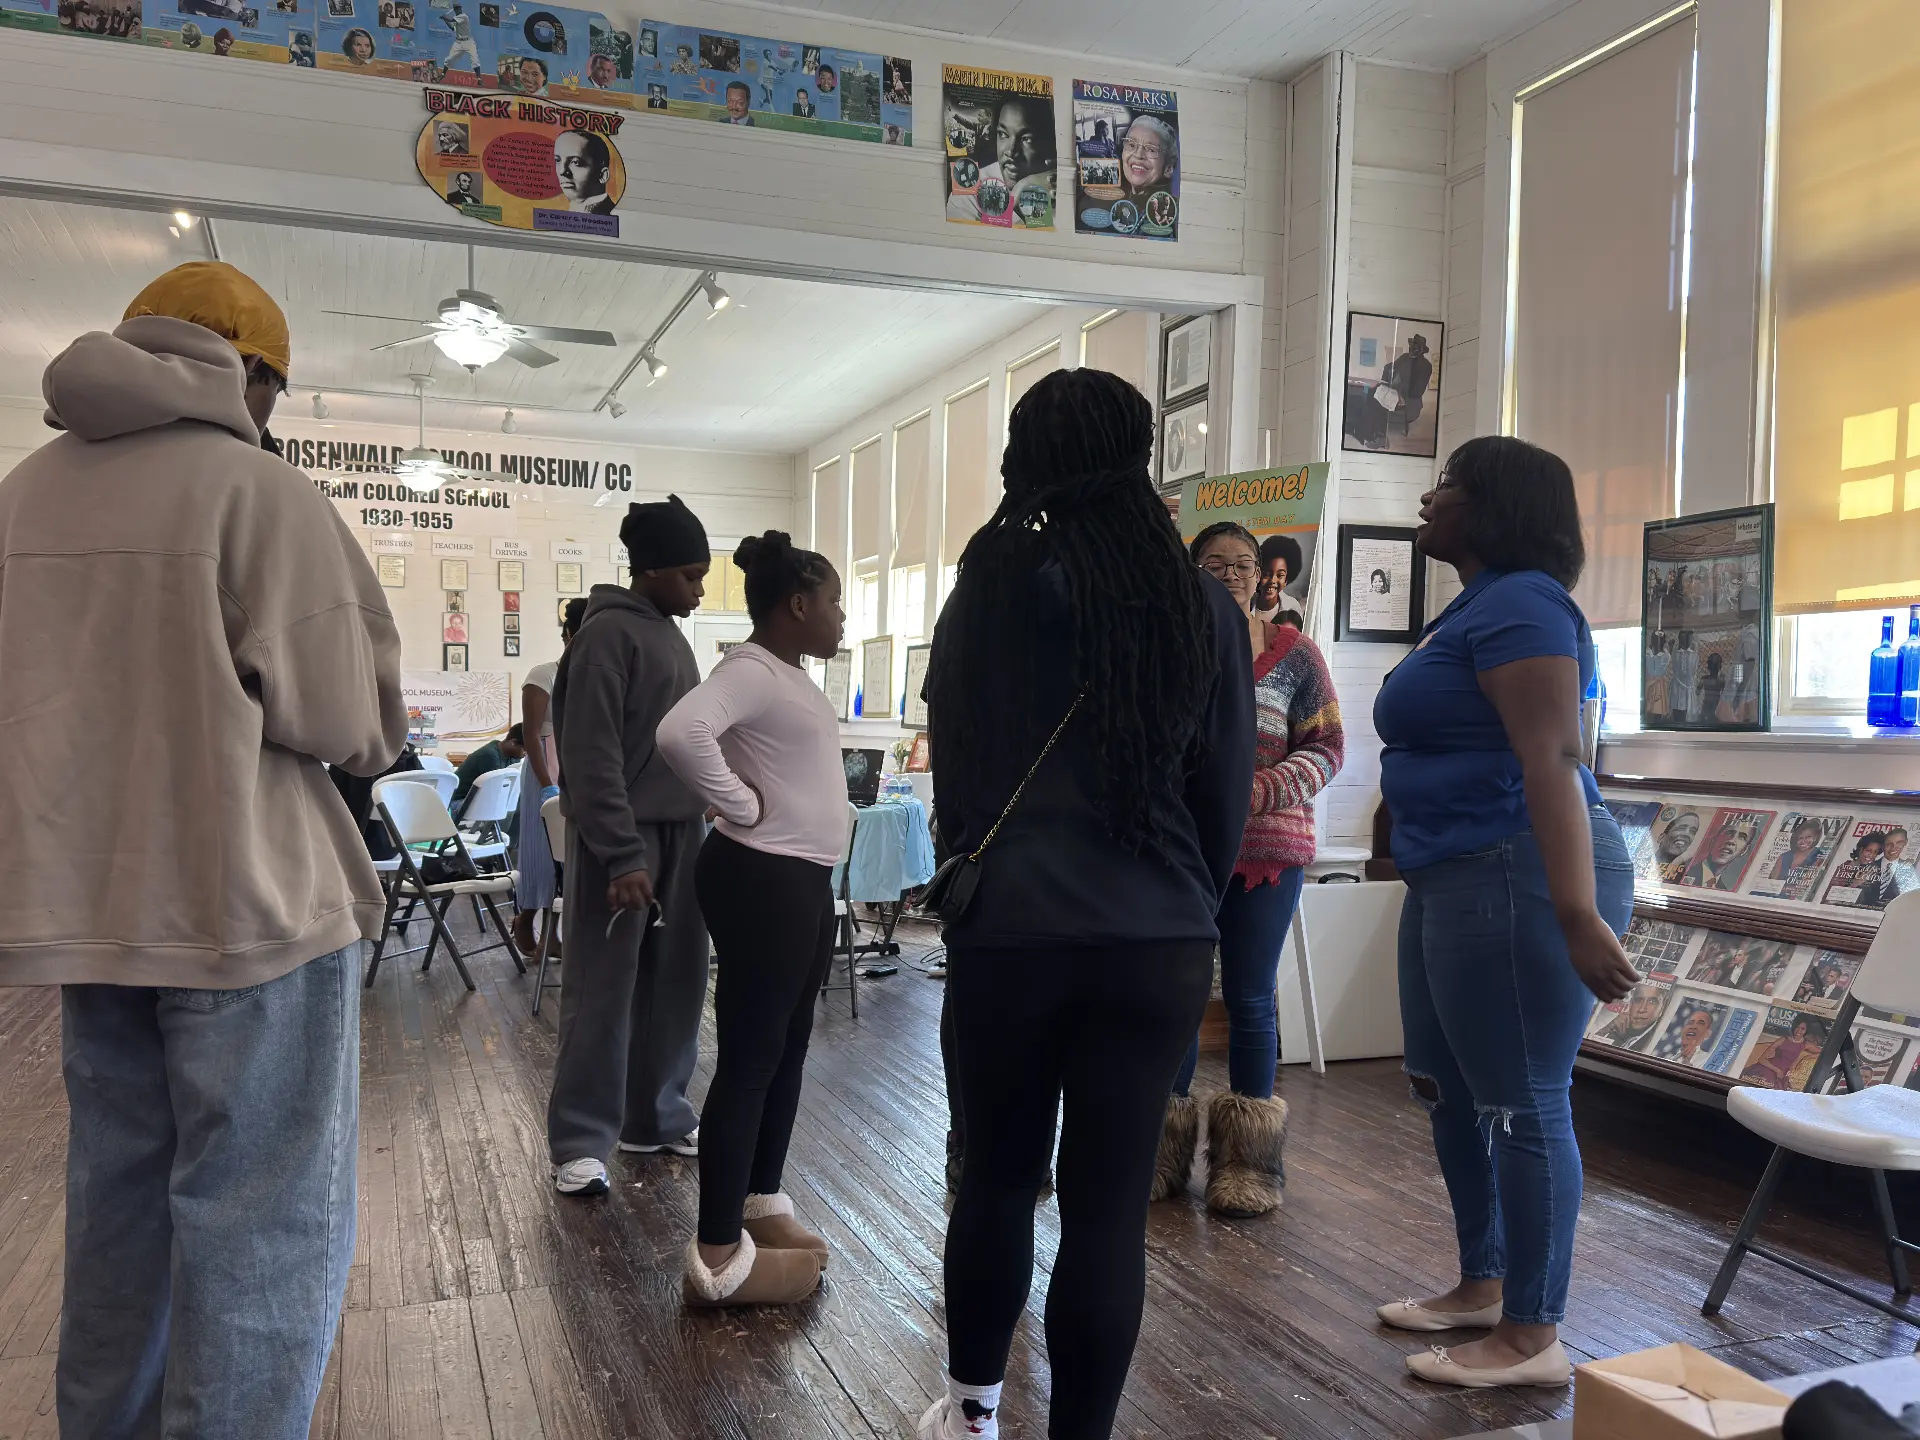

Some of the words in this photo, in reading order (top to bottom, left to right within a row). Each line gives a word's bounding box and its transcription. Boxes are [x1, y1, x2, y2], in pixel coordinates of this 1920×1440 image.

[944, 67, 980, 87] MARTIN
[982, 72, 1015, 92] LUTHER
[1083, 84, 1120, 101] ROSA
[1124, 88, 1168, 107] PARKS
[427, 90, 511, 119] BLACK
[518, 102, 624, 135] HISTORY
[604, 462, 632, 492] CC
[363, 483, 440, 504] COLORED
[444, 488, 511, 509] SCHOOL
[1195, 465, 1309, 511] Welcome!
[360, 508, 453, 530] 1930-1955
[1245, 516, 1271, 527] STEM
[1273, 513, 1296, 525] DAY
[373, 539, 413, 547] TRUSTEES
[433, 542, 474, 550] TEACHERS
[503, 541, 519, 549] BUS
[558, 548, 583, 556] COOKS
[495, 549, 528, 557] DRIVERS
[401, 689, 418, 697] OOL
[1722, 811, 1765, 828] TIME
[1780, 815, 1849, 837] EBNY
[1639, 978, 1673, 991] RPRISE
[1767, 1016, 1793, 1028] WEEKEN
[1779, 1008, 1798, 1020] USA
[1736, 1013, 1753, 1041] AFRICAN
[1705, 1010, 1747, 1072] HERITAGE
[1716, 1042, 1739, 1073] AMERICAN
